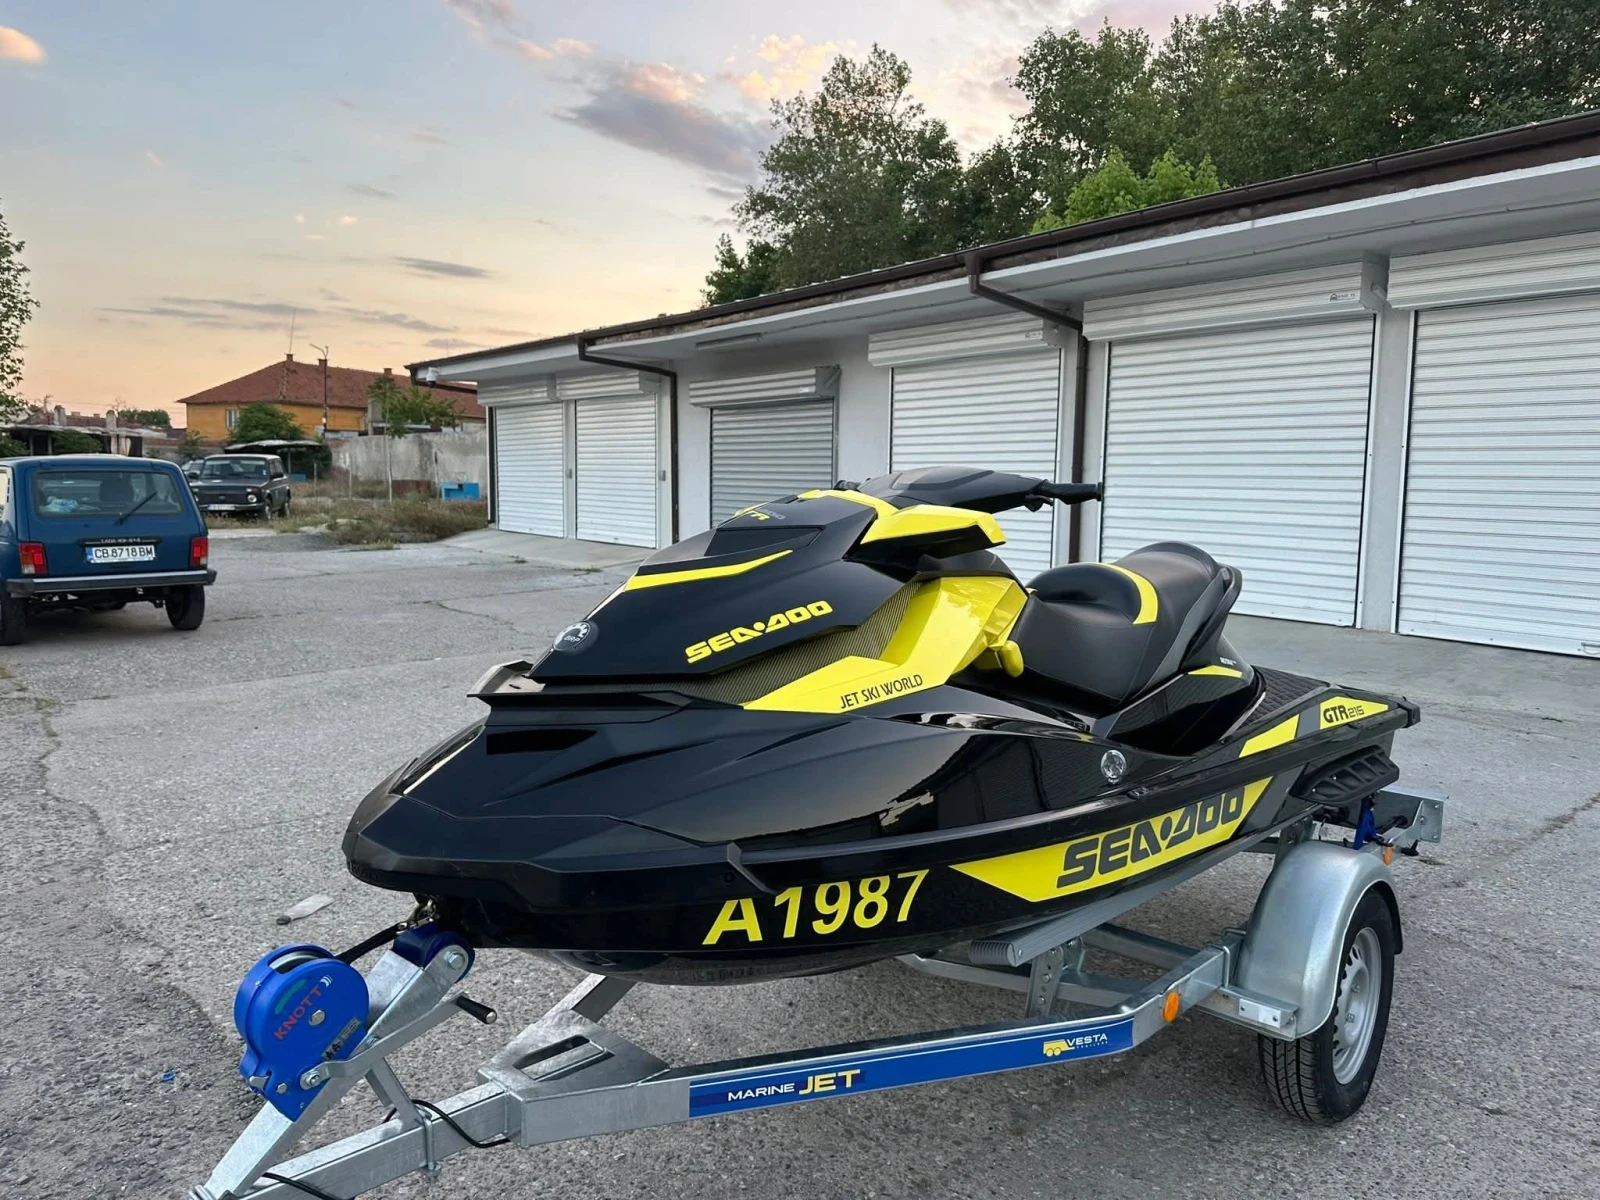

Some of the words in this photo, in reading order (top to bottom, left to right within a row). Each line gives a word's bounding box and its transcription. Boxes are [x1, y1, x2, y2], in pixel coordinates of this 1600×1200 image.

[111, 547, 138, 558] 8718
[138, 546, 153, 557] BM
[840, 691, 860, 709] JET
[861, 685, 881, 702] SKI
[880, 674, 924, 696] WORLD
[273, 984, 322, 1041] KNOTT
[1066, 1032, 1108, 1047] VESTA
[727, 1082, 796, 1102] MARINE
[798, 1069, 861, 1096] JET
